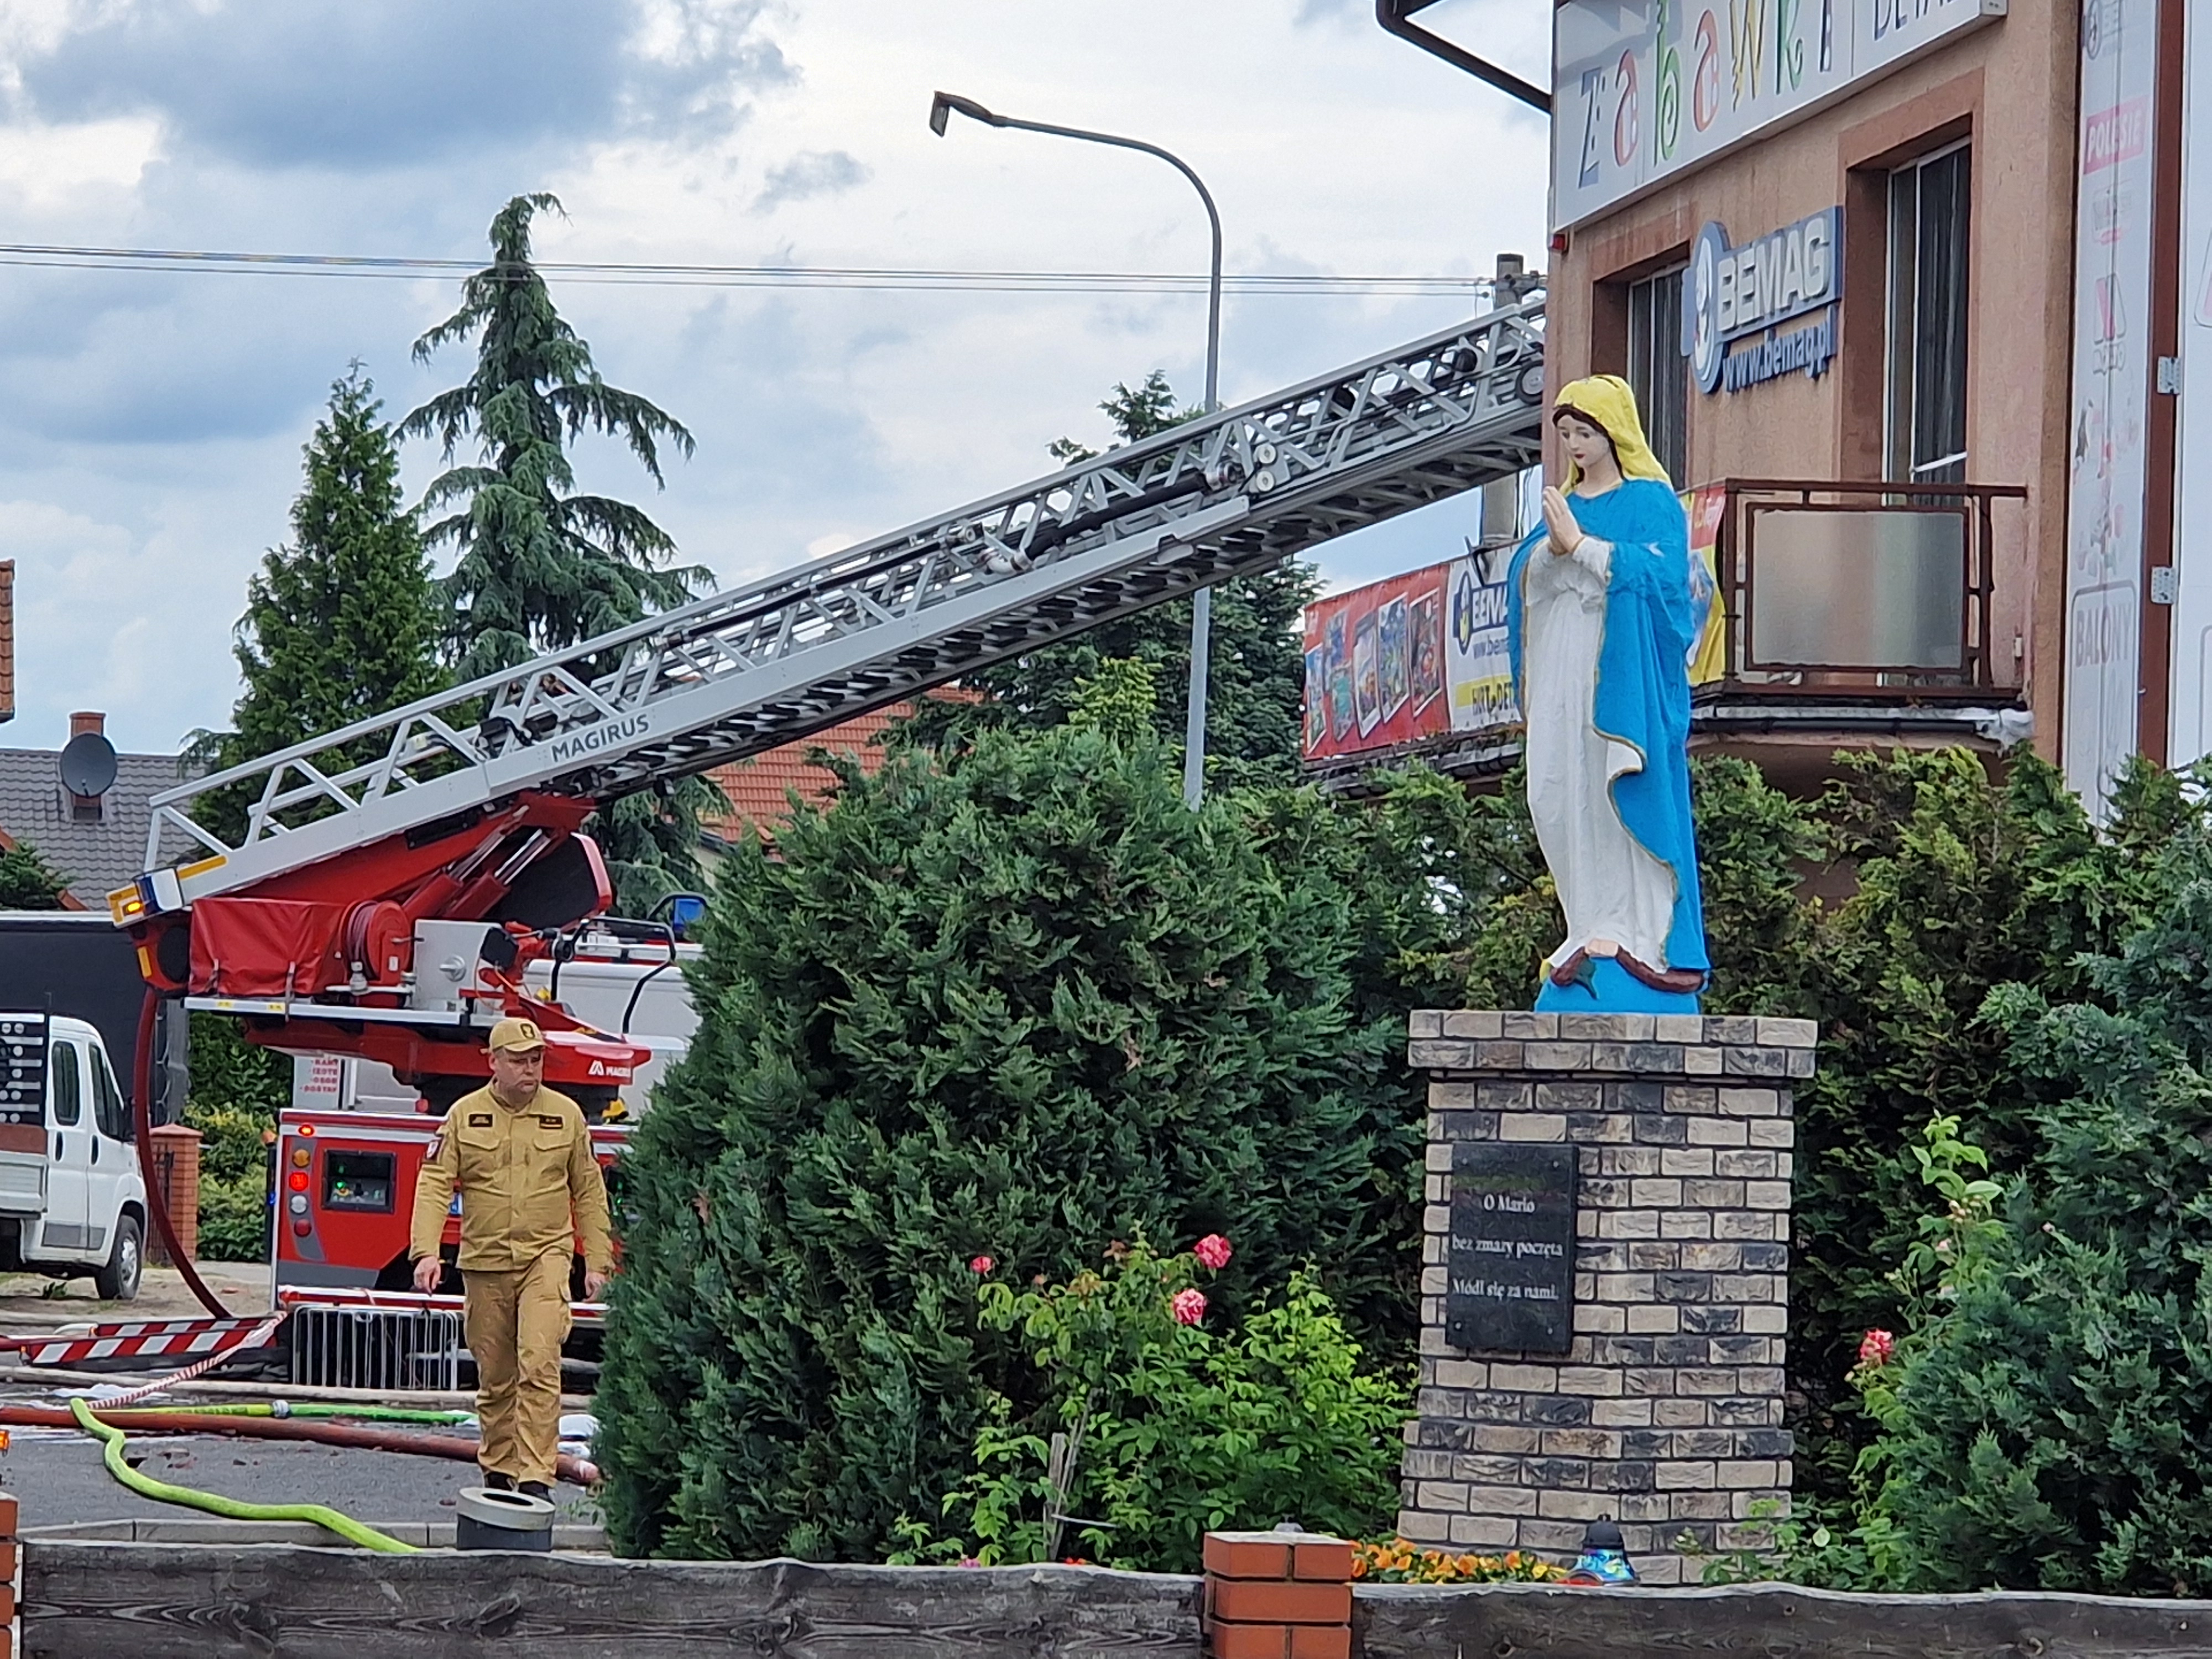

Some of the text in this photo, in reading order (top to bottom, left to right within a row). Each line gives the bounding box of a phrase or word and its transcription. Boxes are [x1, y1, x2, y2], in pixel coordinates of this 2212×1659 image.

[1718, 217, 1829, 332] BEMAG
[1723, 304, 1835, 395] www.bemag.pl
[1473, 585, 1508, 629] BEM
[552, 714, 650, 763] MAGIRUS
[1484, 1194, 1495, 1211] O
[1507, 1285, 1521, 1298] za
